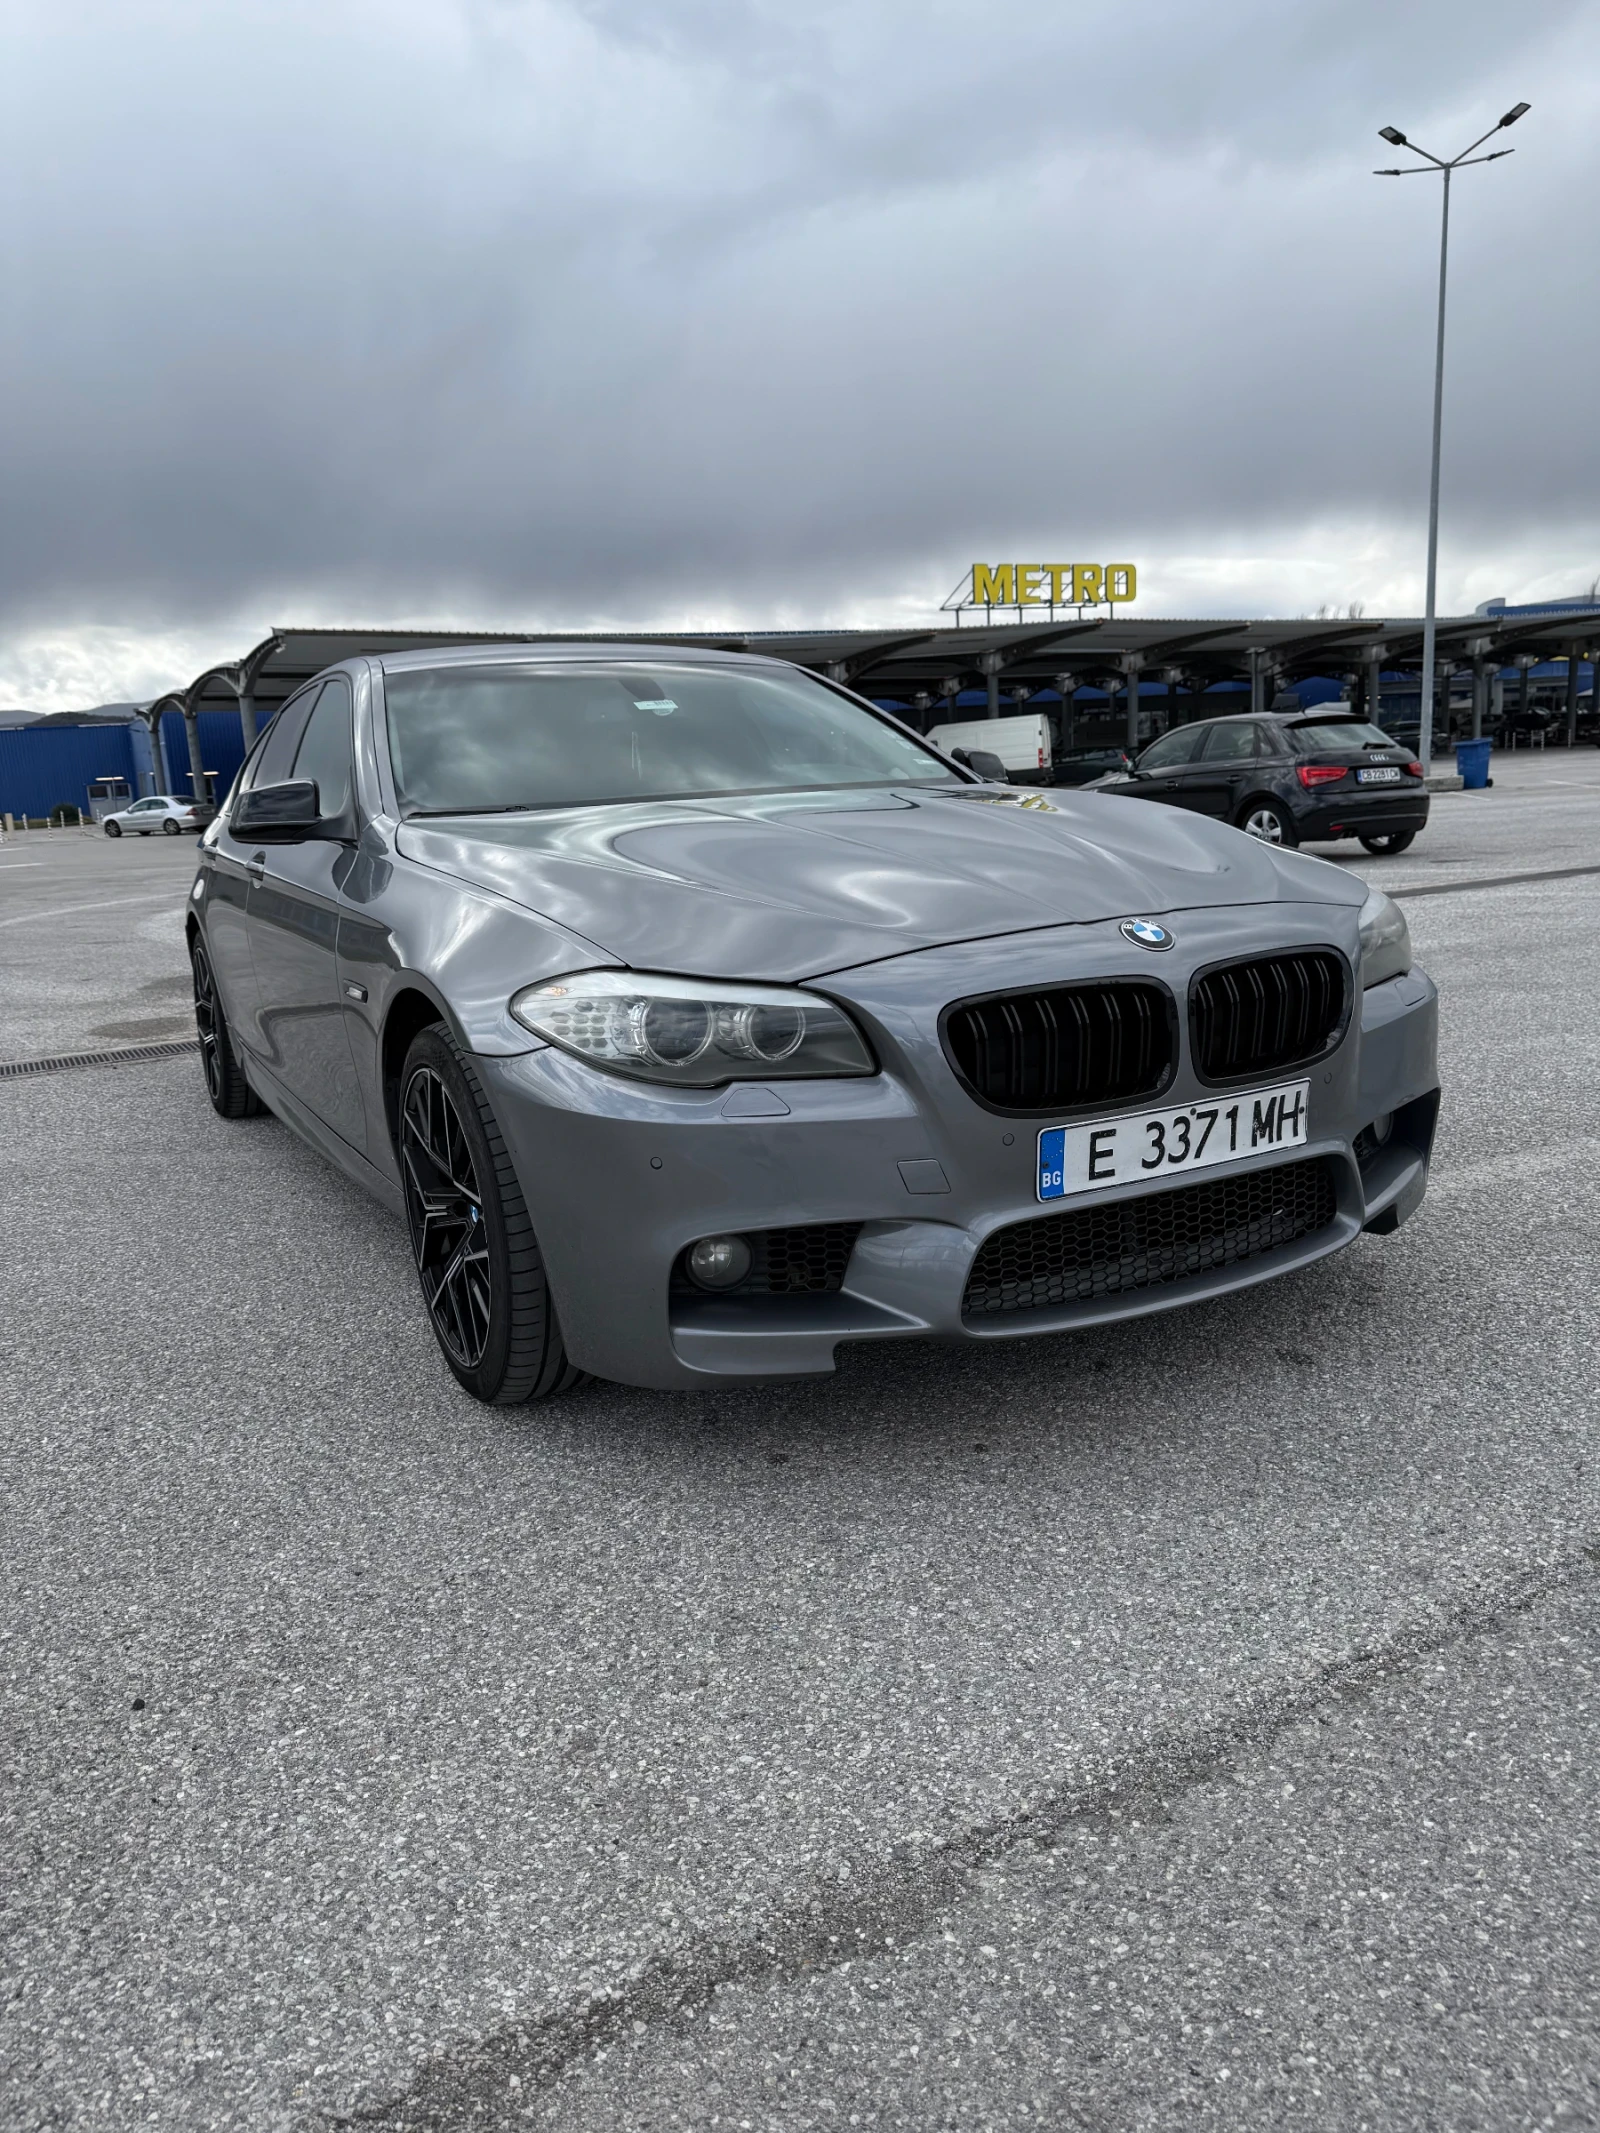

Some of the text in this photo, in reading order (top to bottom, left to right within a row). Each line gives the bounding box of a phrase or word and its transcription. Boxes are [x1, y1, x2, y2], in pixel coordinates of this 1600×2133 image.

[973, 564, 1136, 604] METRO
[1088, 1090, 1302, 1181] E 3371 MH
[1042, 1170, 1061, 1188] BG
